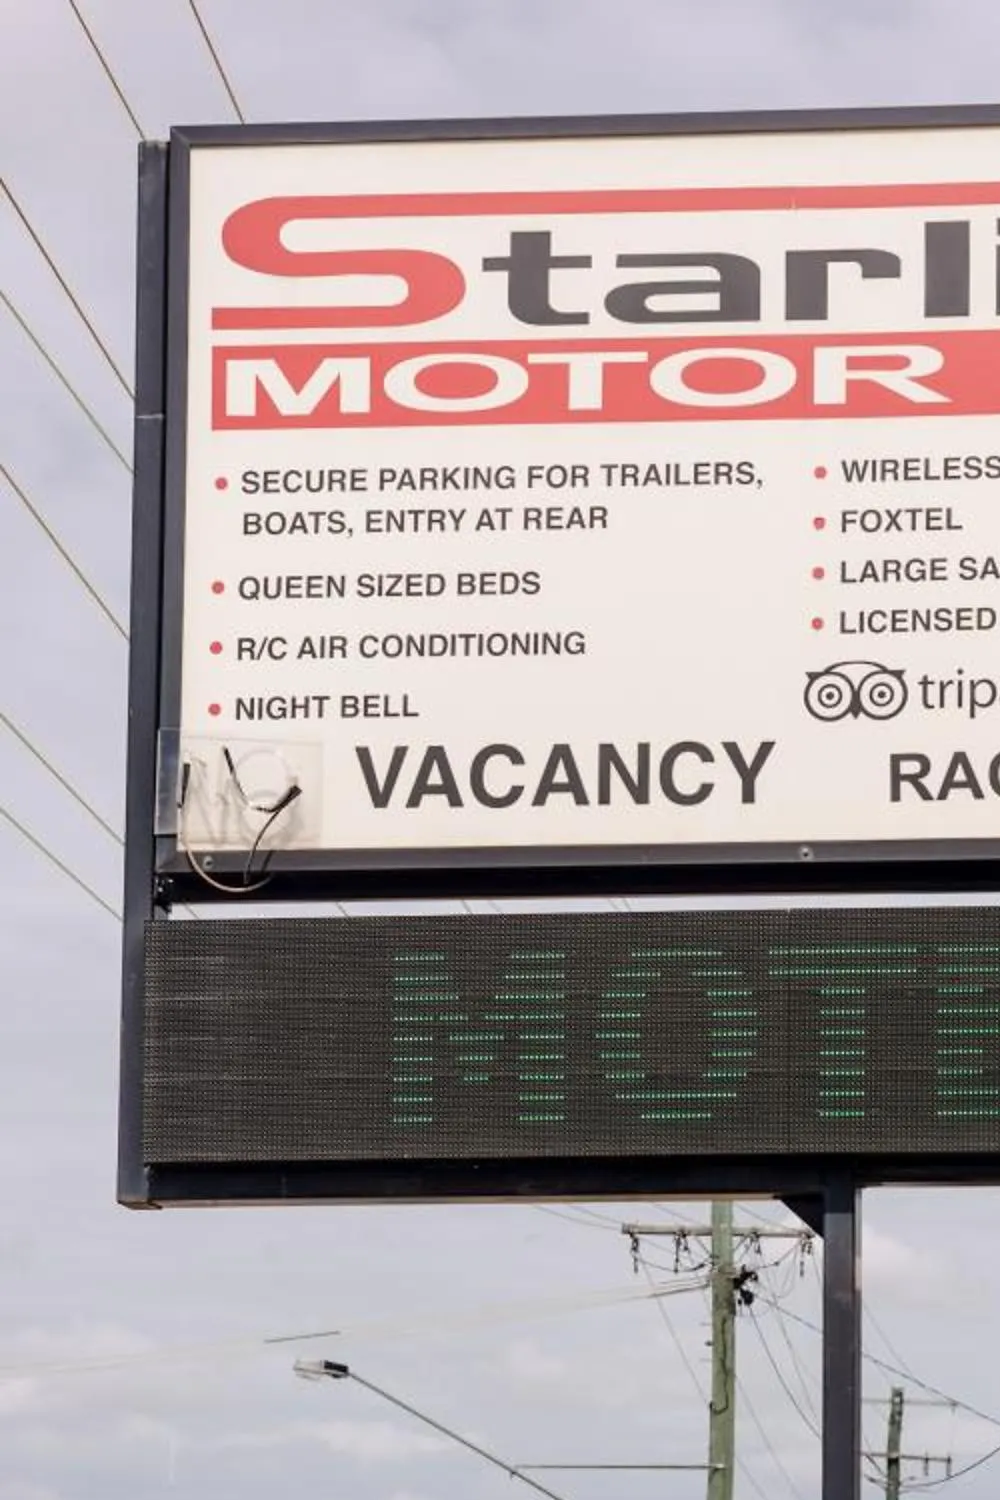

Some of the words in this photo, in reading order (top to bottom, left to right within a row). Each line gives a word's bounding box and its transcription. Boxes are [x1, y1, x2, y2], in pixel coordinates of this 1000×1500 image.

[225, 344, 953, 417] MOTOR
[241, 468, 368, 495] SECURE
[379, 465, 516, 492] PARKING
[527, 464, 590, 489] FOR
[599, 461, 763, 487] TRAILERS,
[243, 510, 353, 537] BOATS,
[365, 508, 467, 533] ENTRY
[475, 507, 513, 532] AT
[523, 505, 608, 531] REAR
[841, 507, 963, 534] FOXTEL
[840, 557, 948, 584] LARGE
[238, 575, 346, 601] QUEEN
[356, 573, 446, 599] SIZED
[456, 571, 541, 596] BEDS
[839, 607, 997, 635] LICENSED
[237, 636, 288, 661] R/C
[296, 635, 348, 660] AIR
[359, 631, 586, 659] CONDITIONING
[235, 695, 331, 721] NIGHT
[340, 693, 420, 719] BELL
[355, 740, 777, 809] VACANCY
